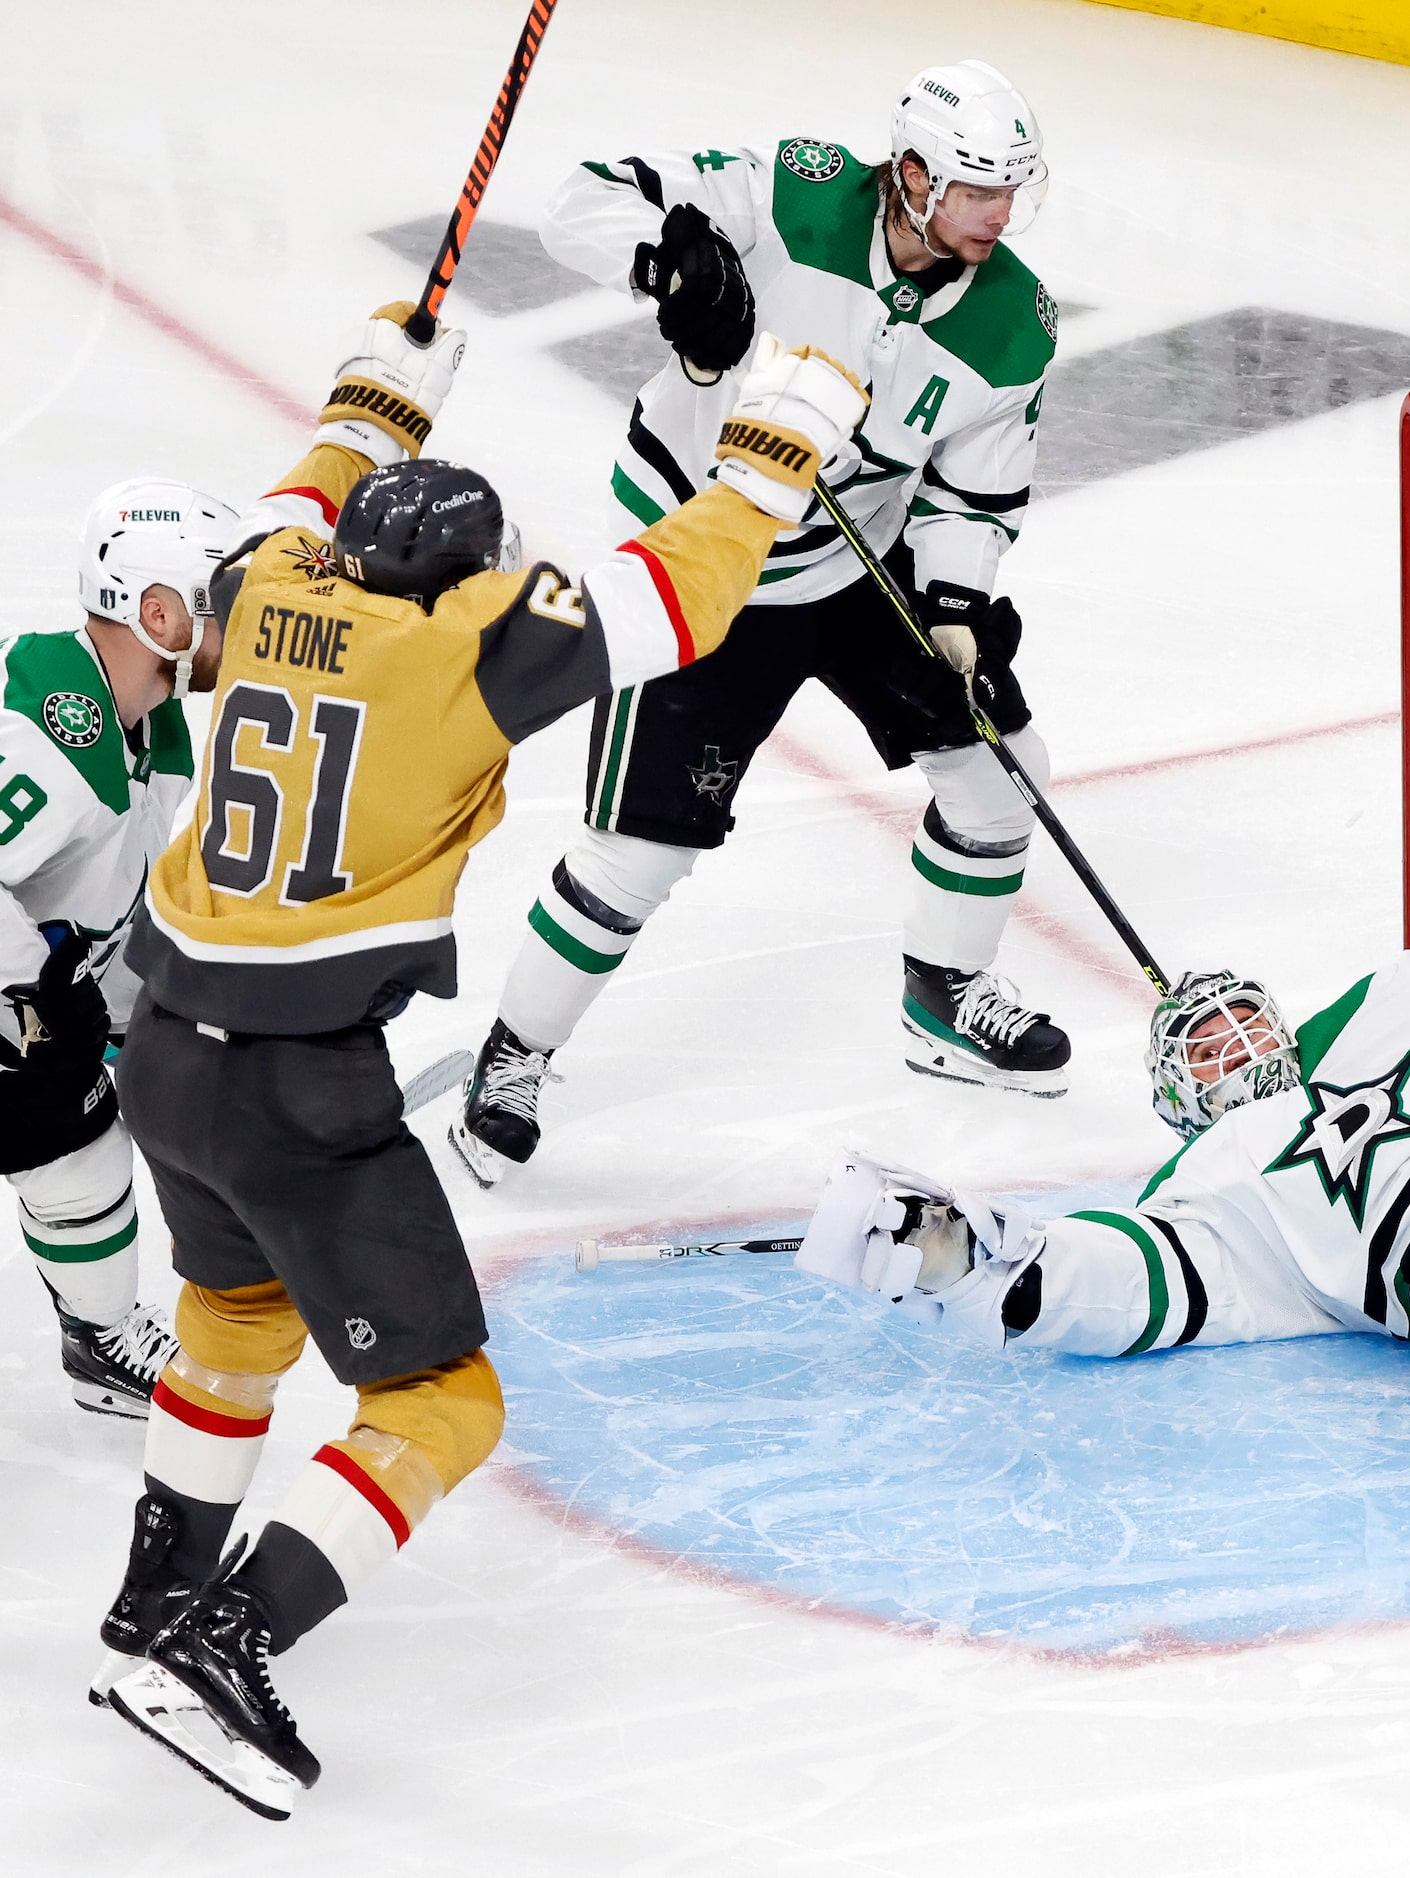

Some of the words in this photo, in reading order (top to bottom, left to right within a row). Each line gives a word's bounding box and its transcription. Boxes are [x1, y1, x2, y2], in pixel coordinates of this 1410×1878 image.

[1014, 119, 1027, 138] 4
[1006, 153, 1037, 167] CCM
[903, 374, 951, 436] A
[431, 489, 484, 514] CreditOne
[343, 553, 365, 581] 61
[938, 596, 971, 609] CCM
[254, 604, 354, 675] STONE
[200, 678, 368, 907] 61
